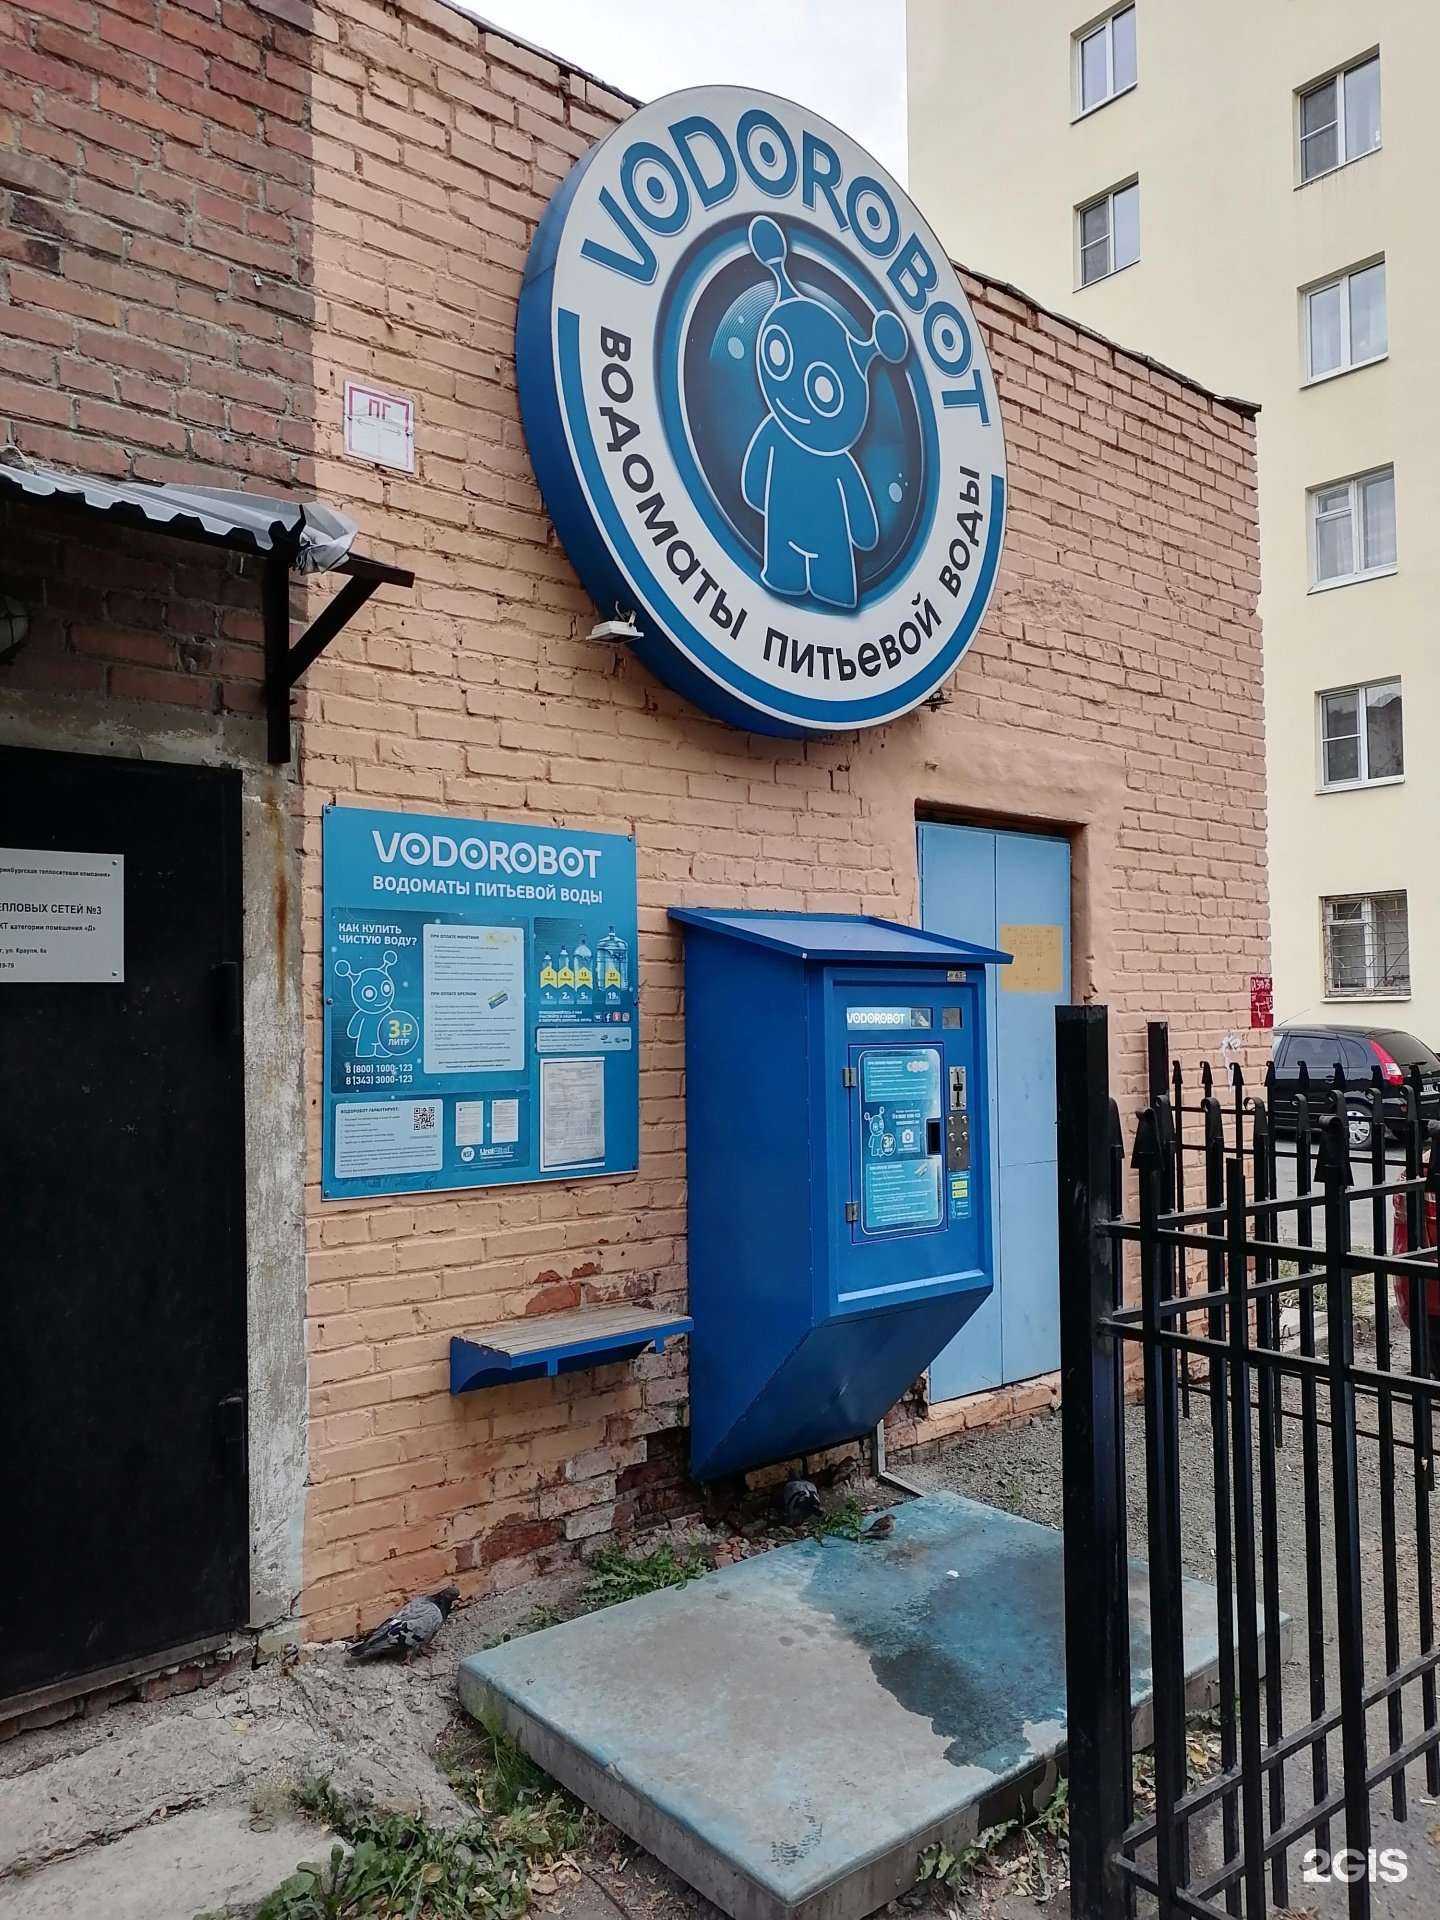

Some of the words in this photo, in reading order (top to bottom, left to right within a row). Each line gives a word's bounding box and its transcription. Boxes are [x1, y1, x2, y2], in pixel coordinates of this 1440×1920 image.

[579, 108, 991, 429] VODOROBOT
[371, 830, 602, 879] VODOROBOT
[372, 875, 470, 895] ВОДОМАТЫ
[474, 882, 556, 901] ПИТЬЕВОЙ
[560, 887, 603, 905] ВОДЫ
[50, 903, 84, 914] СЕТЕЙ
[86, 905, 102, 915] №3
[10, 924, 44, 932] категории
[338, 922, 360, 933] КАК
[362, 924, 402, 934] КУПИТЬ
[338, 934, 382, 945] ЧИСТУЮ
[384, 936, 418, 948] ВОДУ?
[846, 1012, 906, 1025] VODOROBOT
[387, 1038, 410, 1046] ЛИТР
[352, 1064, 374, 1074] (800)
[376, 1063, 413, 1073] 1000-123
[345, 1076, 352, 1085] 8
[352, 1075, 374, 1086] (343)
[375, 1074, 413, 1084] 3000-123
